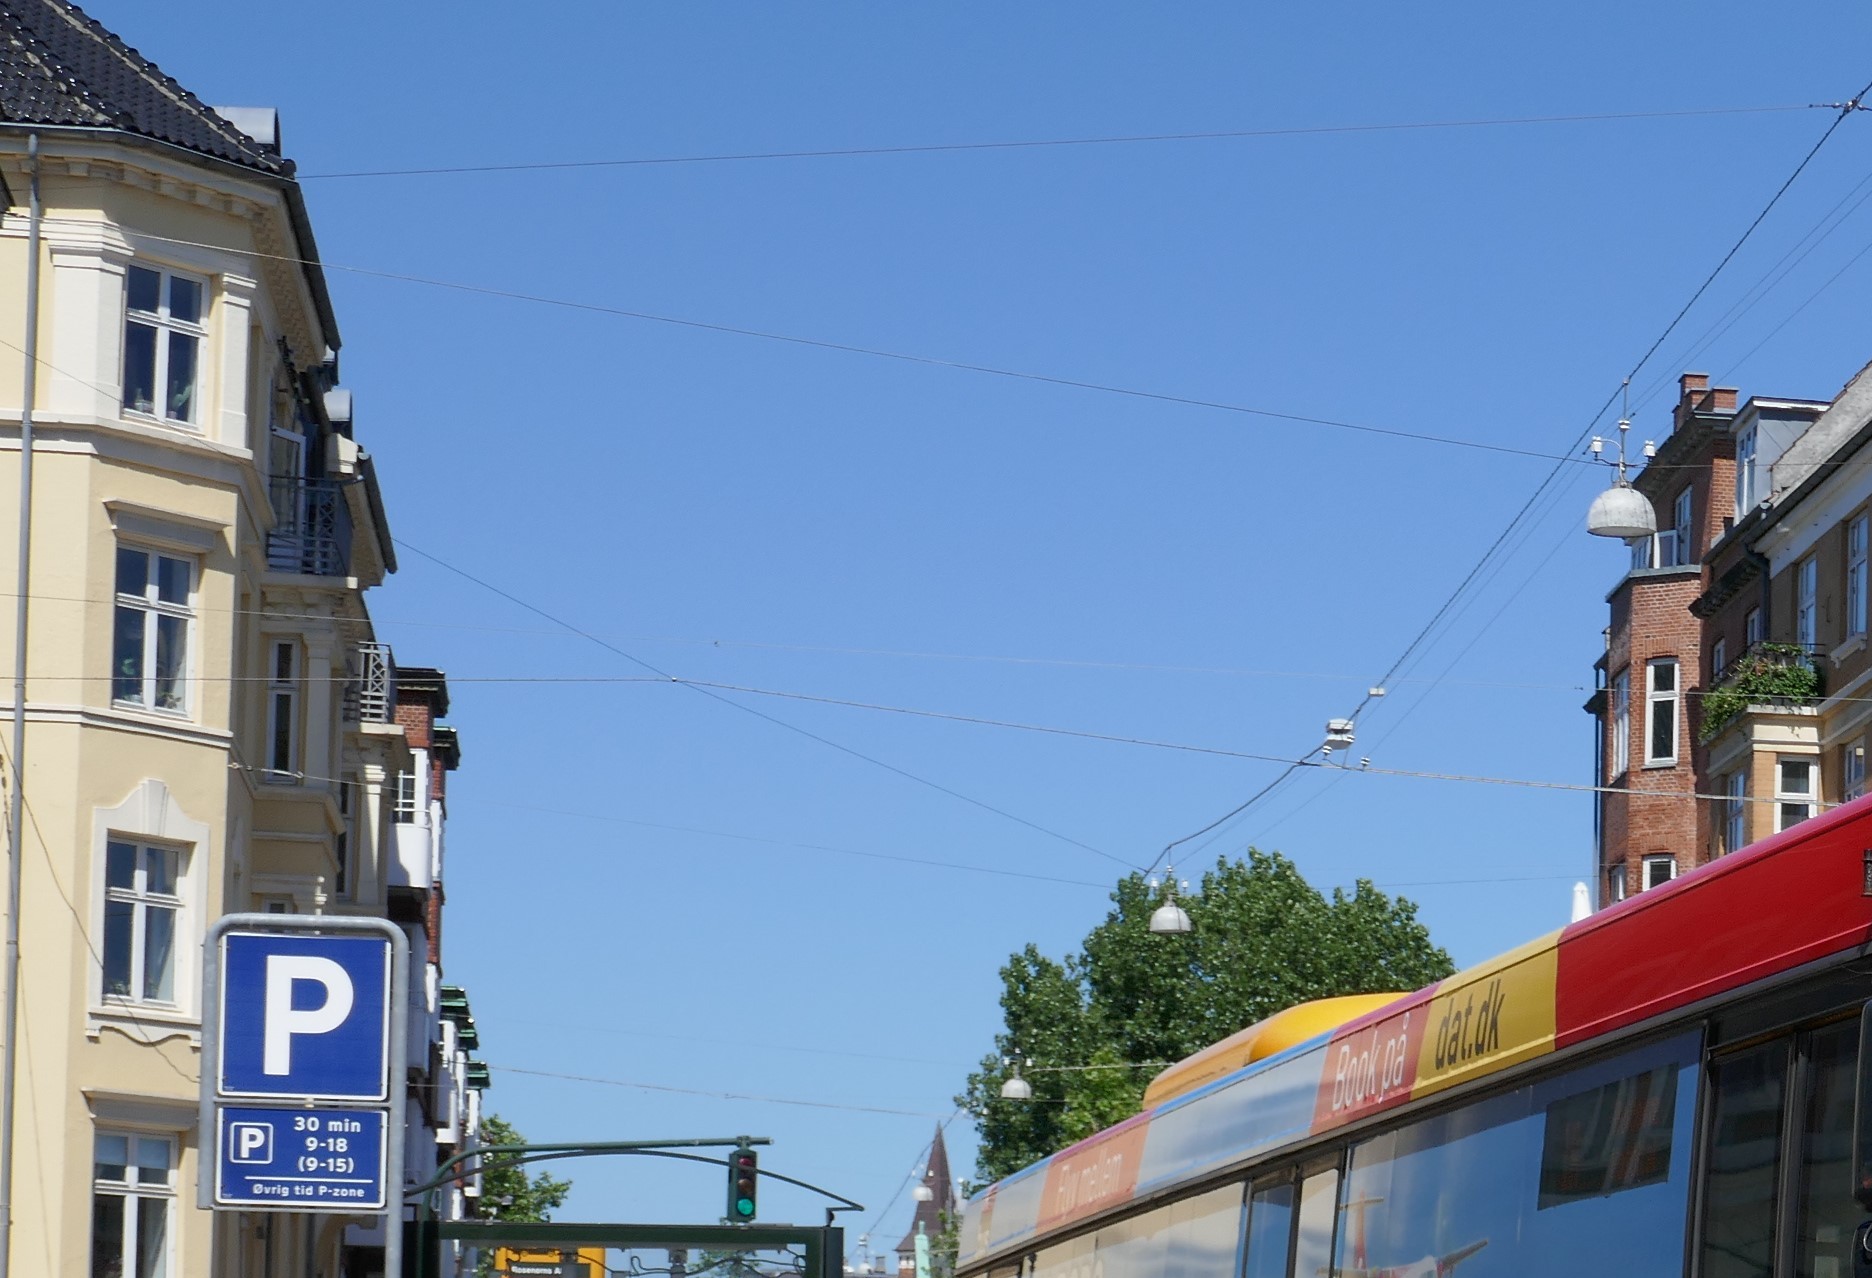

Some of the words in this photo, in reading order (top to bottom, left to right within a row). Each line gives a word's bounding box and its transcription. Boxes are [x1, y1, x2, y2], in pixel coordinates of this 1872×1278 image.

[263, 955, 354, 1076] P
[1332, 1030, 1380, 1111] Book
[1378, 1011, 1411, 1104] på
[1434, 978, 1506, 1071] dat.dk
[293, 1116, 320, 1132] 30
[327, 1118, 361, 1133] min
[240, 1127, 265, 1159] P
[305, 1137, 348, 1152] 9-18
[297, 1156, 355, 1174] (9-15)
[252, 1183, 290, 1197] Øvrig
[294, 1185, 314, 1196] tid
[318, 1186, 365, 1198] P-zone
